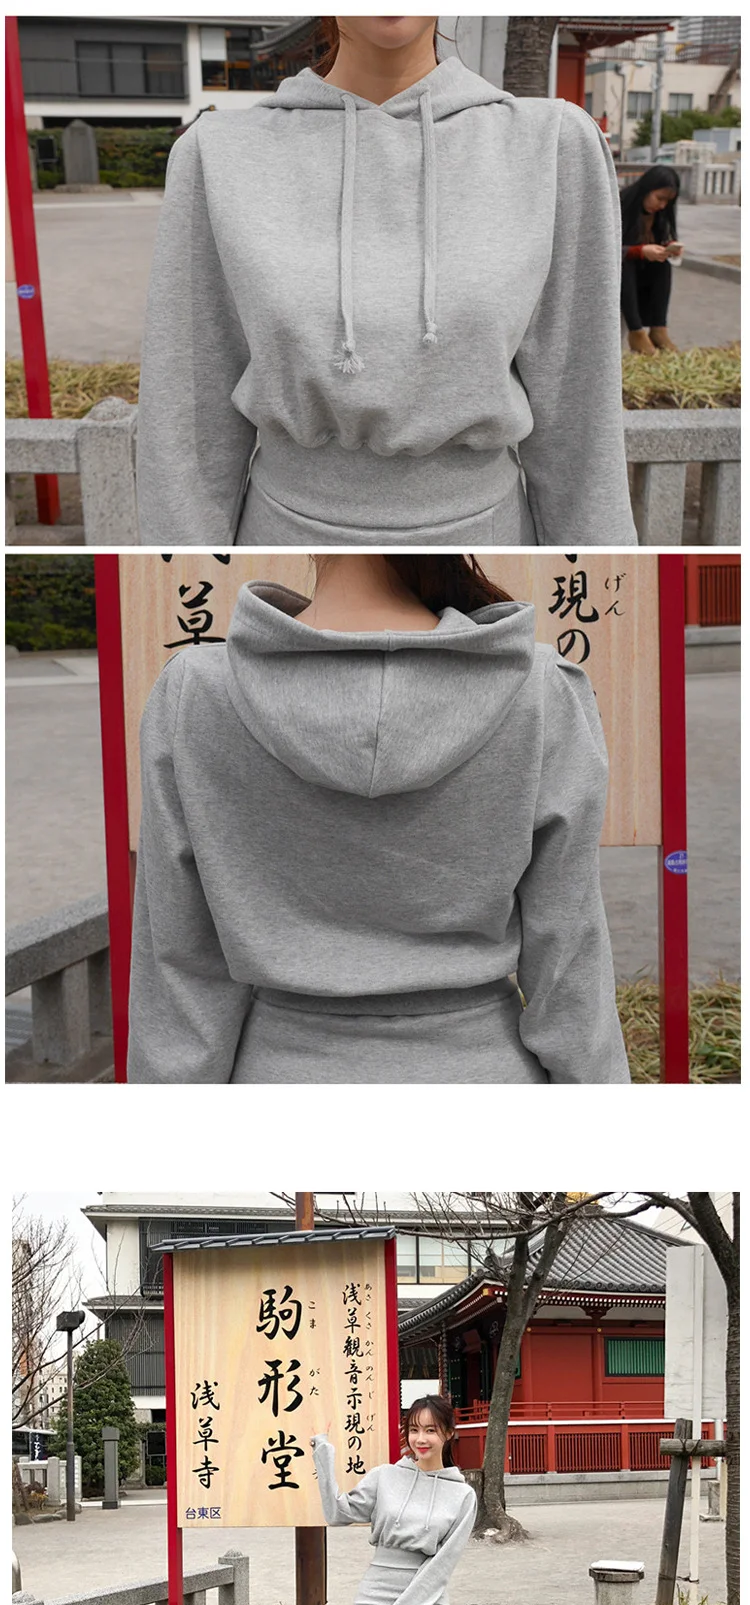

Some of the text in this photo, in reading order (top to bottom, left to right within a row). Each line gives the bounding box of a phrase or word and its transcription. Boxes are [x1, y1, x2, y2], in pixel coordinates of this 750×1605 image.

[161, 554, 229, 649] 草
[548, 554, 600, 664] 現の
[604, 572, 627, 617] げん
[190, 1379, 221, 1489] 浅草寺
[256, 1284, 305, 1490] 駒形堂
[185, 1506, 222, 1520] 台東区
